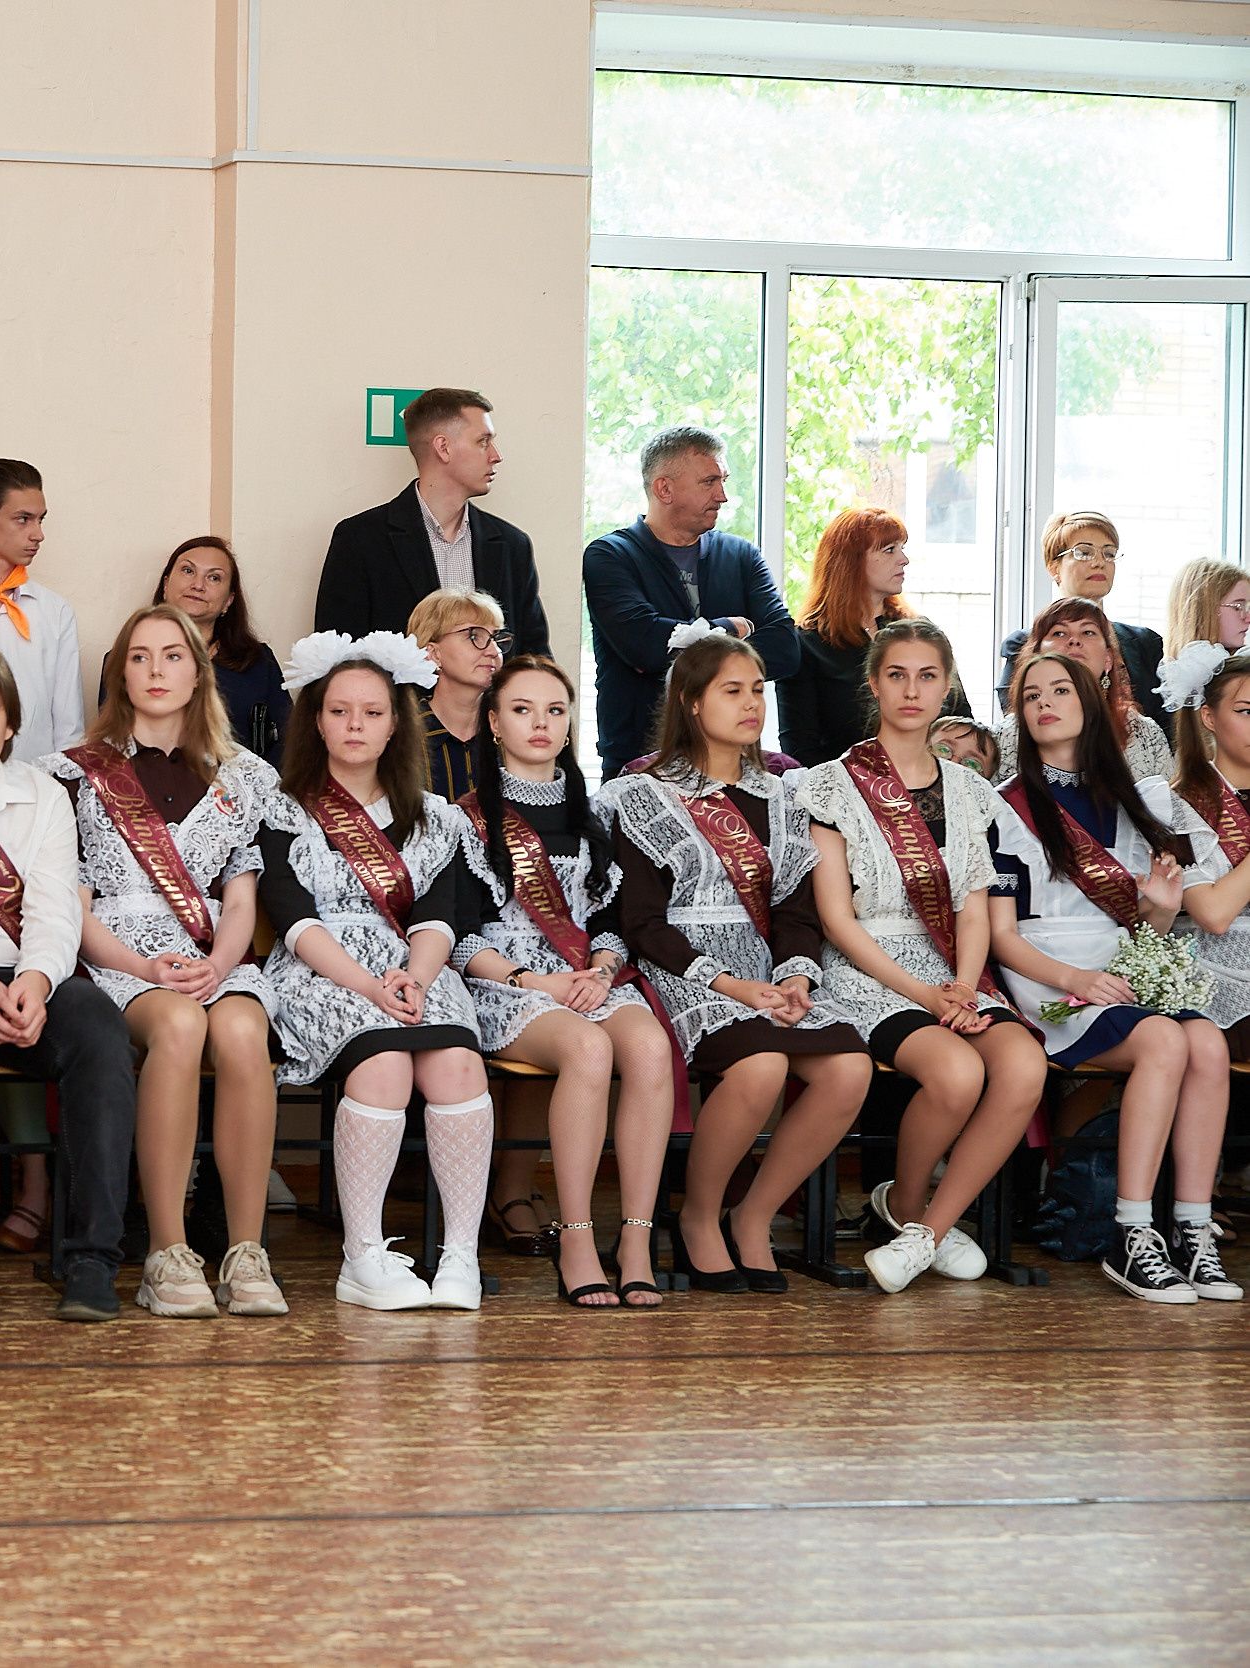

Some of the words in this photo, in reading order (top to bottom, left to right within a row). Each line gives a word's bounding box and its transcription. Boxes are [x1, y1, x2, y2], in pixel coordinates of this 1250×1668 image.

[105, 772, 195, 925] Выпускник
[318, 795, 399, 896] ыпускник
[356, 814, 378, 840] класс
[870, 775, 941, 928] Выпускник
[923, 843, 942, 871] класс
